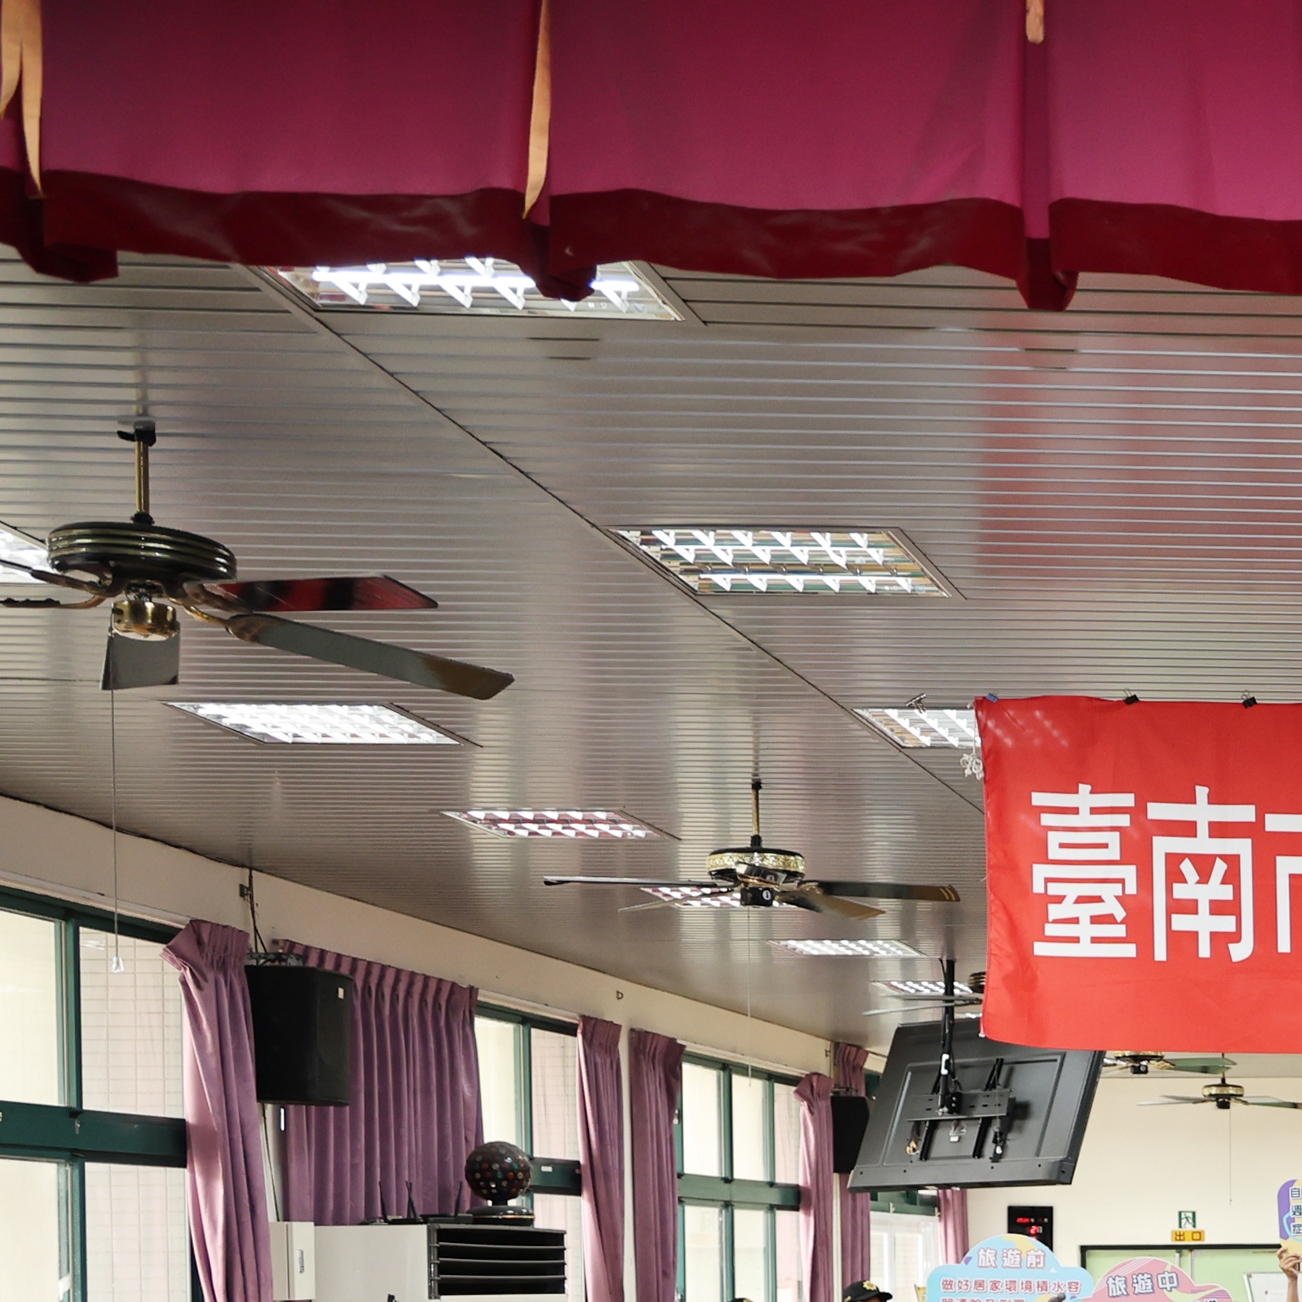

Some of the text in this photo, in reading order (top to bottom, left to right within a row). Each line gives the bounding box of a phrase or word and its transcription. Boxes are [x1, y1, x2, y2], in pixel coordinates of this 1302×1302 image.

[1174, 1230, 1203, 1242] 出口
[976, 1248, 1047, 1269] 旅遊前
[940, 1278, 1082, 1294] 做好居家環境積水容
[1106, 1269, 1180, 1298] 旅遊中
